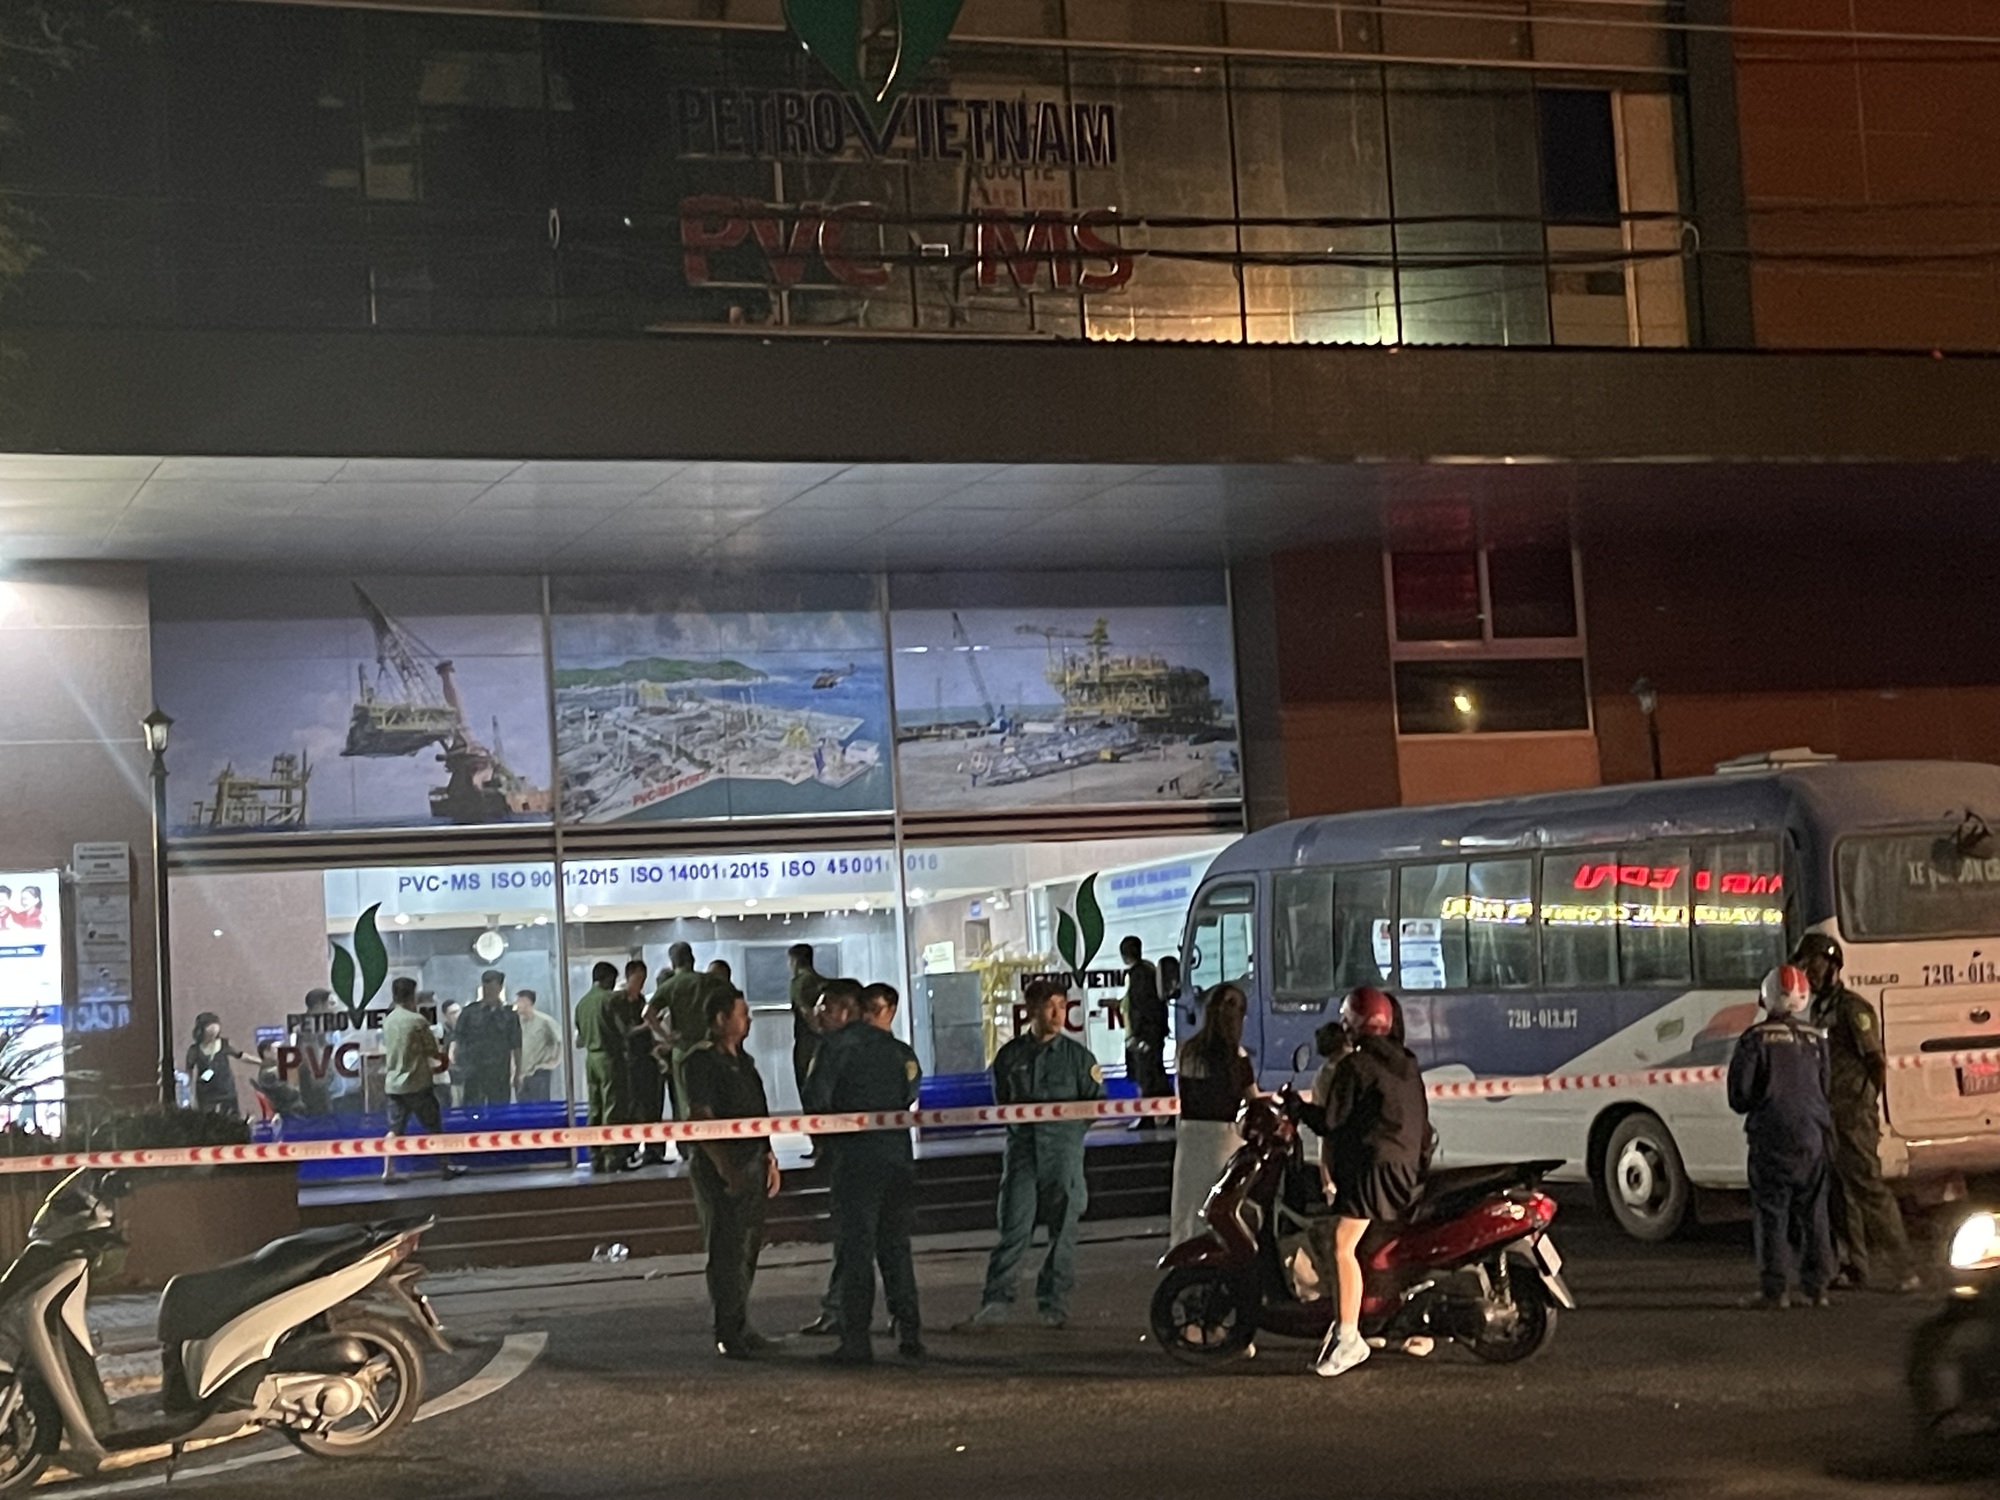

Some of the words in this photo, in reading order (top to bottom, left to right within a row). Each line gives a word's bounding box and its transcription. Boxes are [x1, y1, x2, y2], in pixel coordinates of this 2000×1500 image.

[678, 89, 1118, 167] PETROVIETNAM
[398, 872, 481, 893] PVC-MS
[491, 870, 526, 889] ISO
[531, 867, 618, 888] 901:2015
[630, 866, 663, 884] ISO
[669, 862, 770, 882] 14001:2015
[781, 860, 816, 878] ISO
[826, 853, 938, 875] 45001:018
